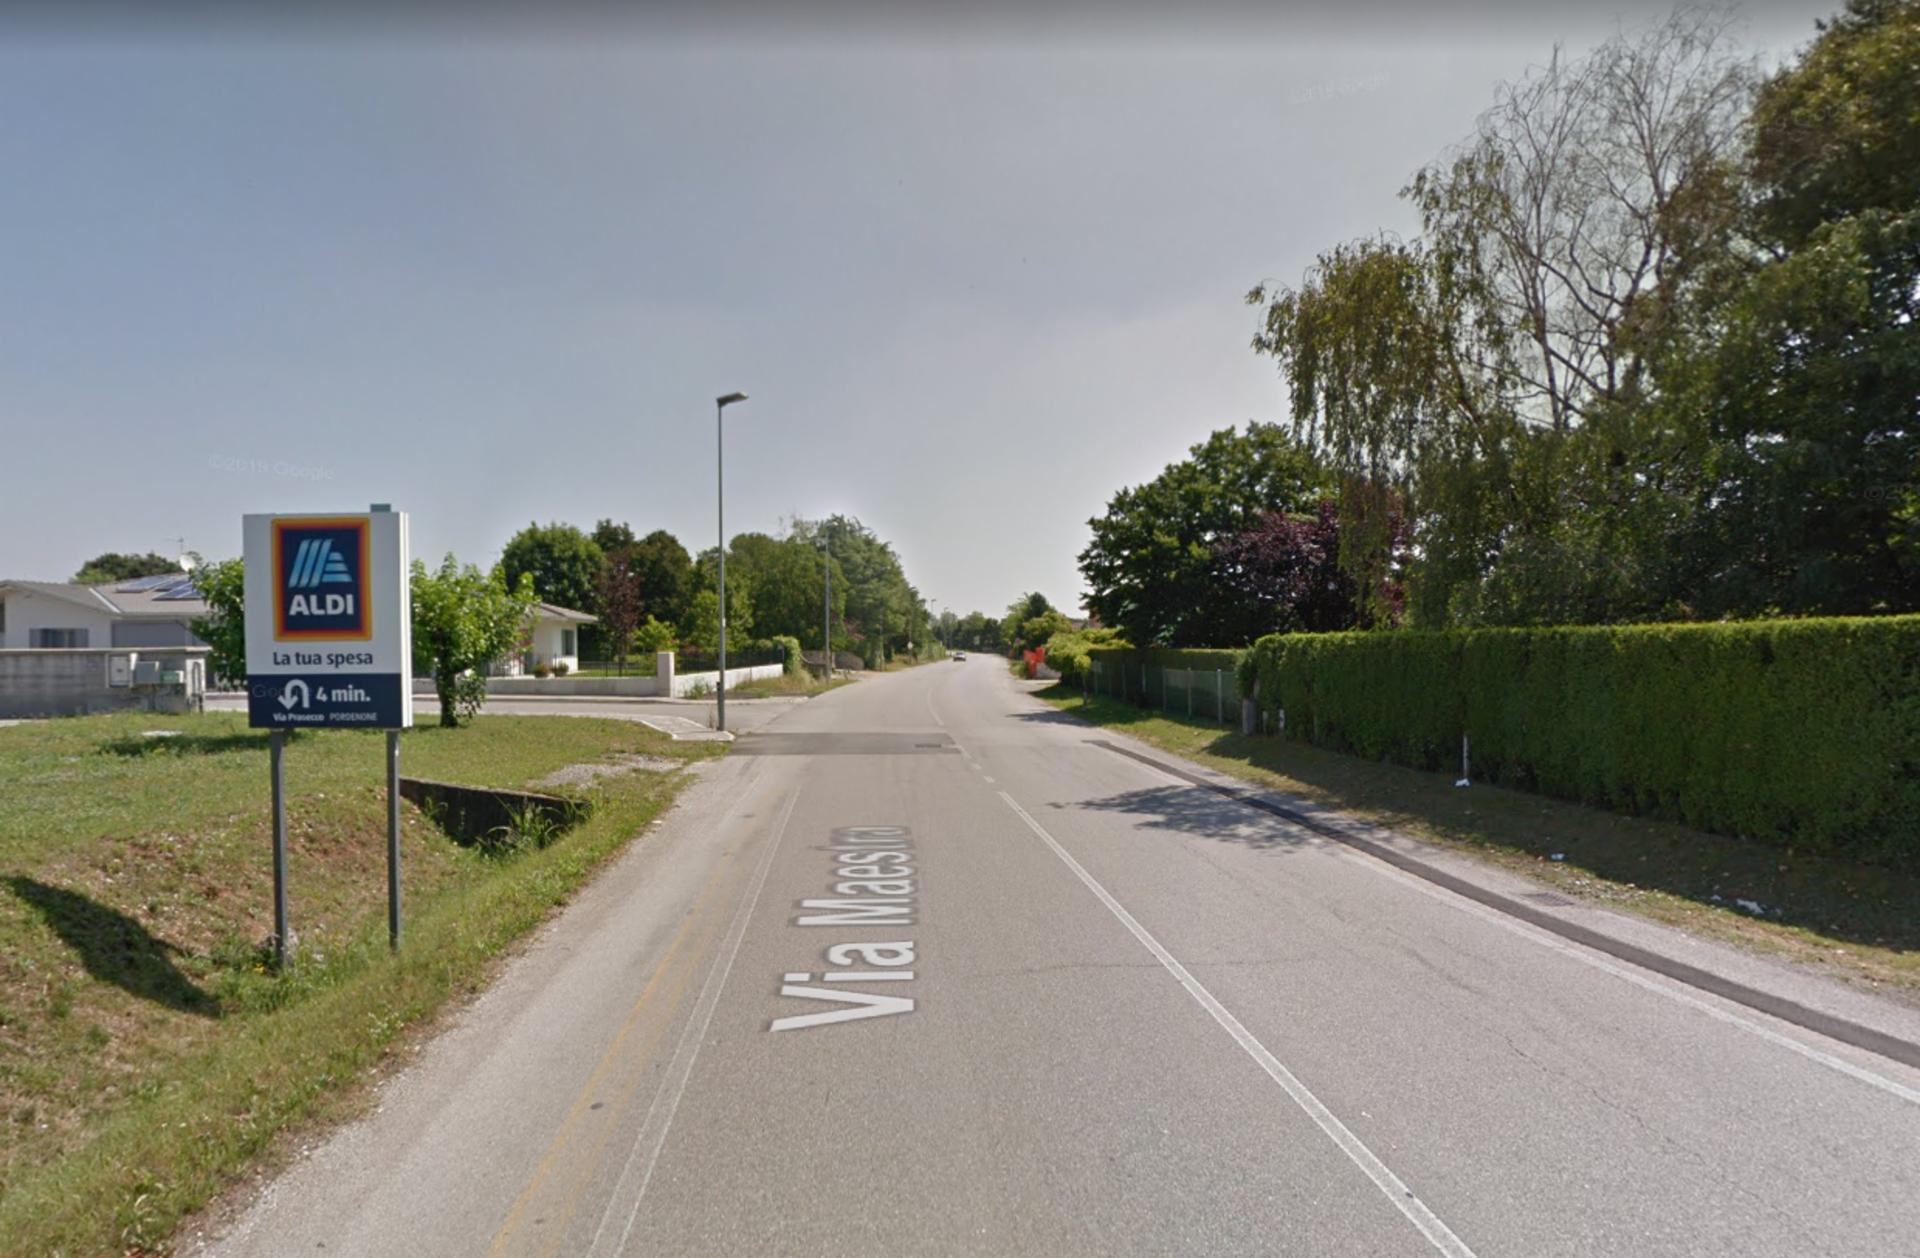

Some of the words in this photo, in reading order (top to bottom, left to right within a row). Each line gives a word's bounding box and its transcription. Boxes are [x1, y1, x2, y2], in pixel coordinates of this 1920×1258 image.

[288, 594, 355, 616] ALDI
[273, 652, 291, 665] La
[295, 652, 322, 666] tua
[326, 652, 373, 668] spesa
[315, 687, 328, 703] 4
[331, 685, 371, 702] min.
[273, 712, 287, 721] Via
